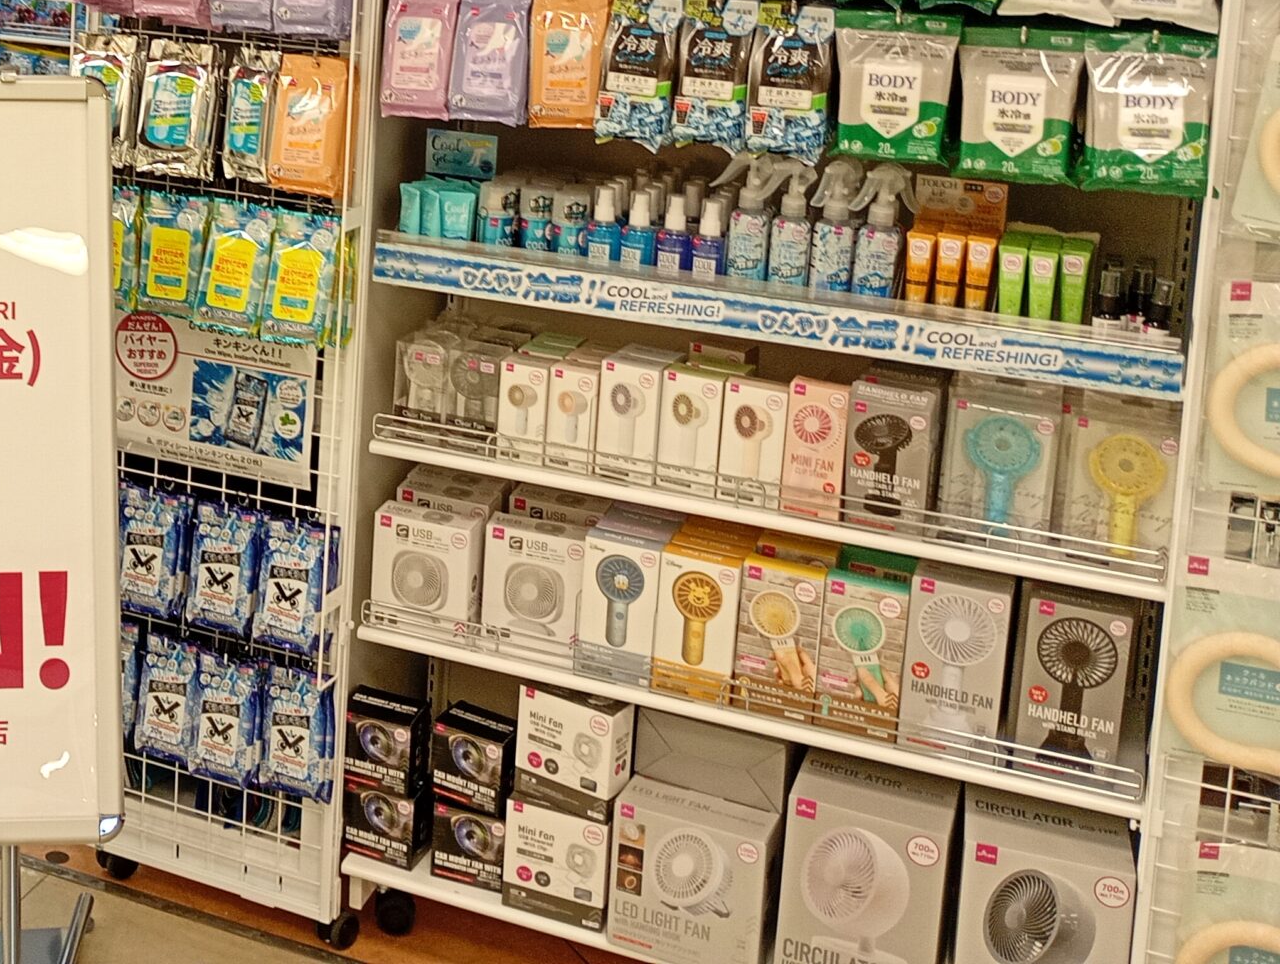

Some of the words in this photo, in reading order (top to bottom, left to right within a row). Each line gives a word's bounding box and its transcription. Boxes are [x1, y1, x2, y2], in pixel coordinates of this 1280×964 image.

[618, 34, 658, 54] 冷爽
[693, 38, 733, 58] 冷爽
[768, 47, 811, 66] 冷爽
[868, 73, 918, 89] BODY
[991, 89, 1041, 106] BODY
[1124, 94, 1178, 110] BODY
[431, 135, 463, 152] Cool
[922, 179, 958, 189] TOUCH
[606, 285, 650, 300] COOL
[652, 292, 668, 301] and
[619, 299, 721, 319] REFRESHING!
[124, 334, 168, 347] バイヤー
[927, 330, 977, 347] COOL
[978, 338, 997, 349] and
[126, 348, 167, 361] おすすめ
[941, 347, 1058, 367] REFRESHING!
[909, 394, 928, 403] FAN
[790, 453, 812, 467] MINI
[815, 458, 834, 473] FAN
[850, 467, 900, 486] HANDHELD
[902, 476, 920, 489] FAN
[432, 502, 453, 513] USB
[546, 510, 566, 523] USB
[412, 527, 433, 540] USB
[526, 539, 548, 551] USB
[911, 680, 969, 703] HANDHELD
[972, 693, 994, 710] FAN
[529, 710, 547, 724] Mini
[549, 717, 564, 730] Fan
[1027, 703, 1088, 728] HANDHELD
[1091, 717, 1115, 734] FAN
[1056, 723, 1076, 734] STAND
[809, 758, 903, 790] CIRCULATOR
[631, 785, 653, 797] LED
[655, 790, 687, 805] LIGHT
[689, 800, 711, 812] FAN
[974, 798, 1074, 829] CIRCULATOR
[518, 824, 536, 837] Mini
[538, 829, 555, 842] Fan
[614, 899, 638, 919] LED
[642, 905, 681, 932] LIGHT
[684, 920, 711, 943] FAN
[782, 937, 885, 964] CIRCUL
